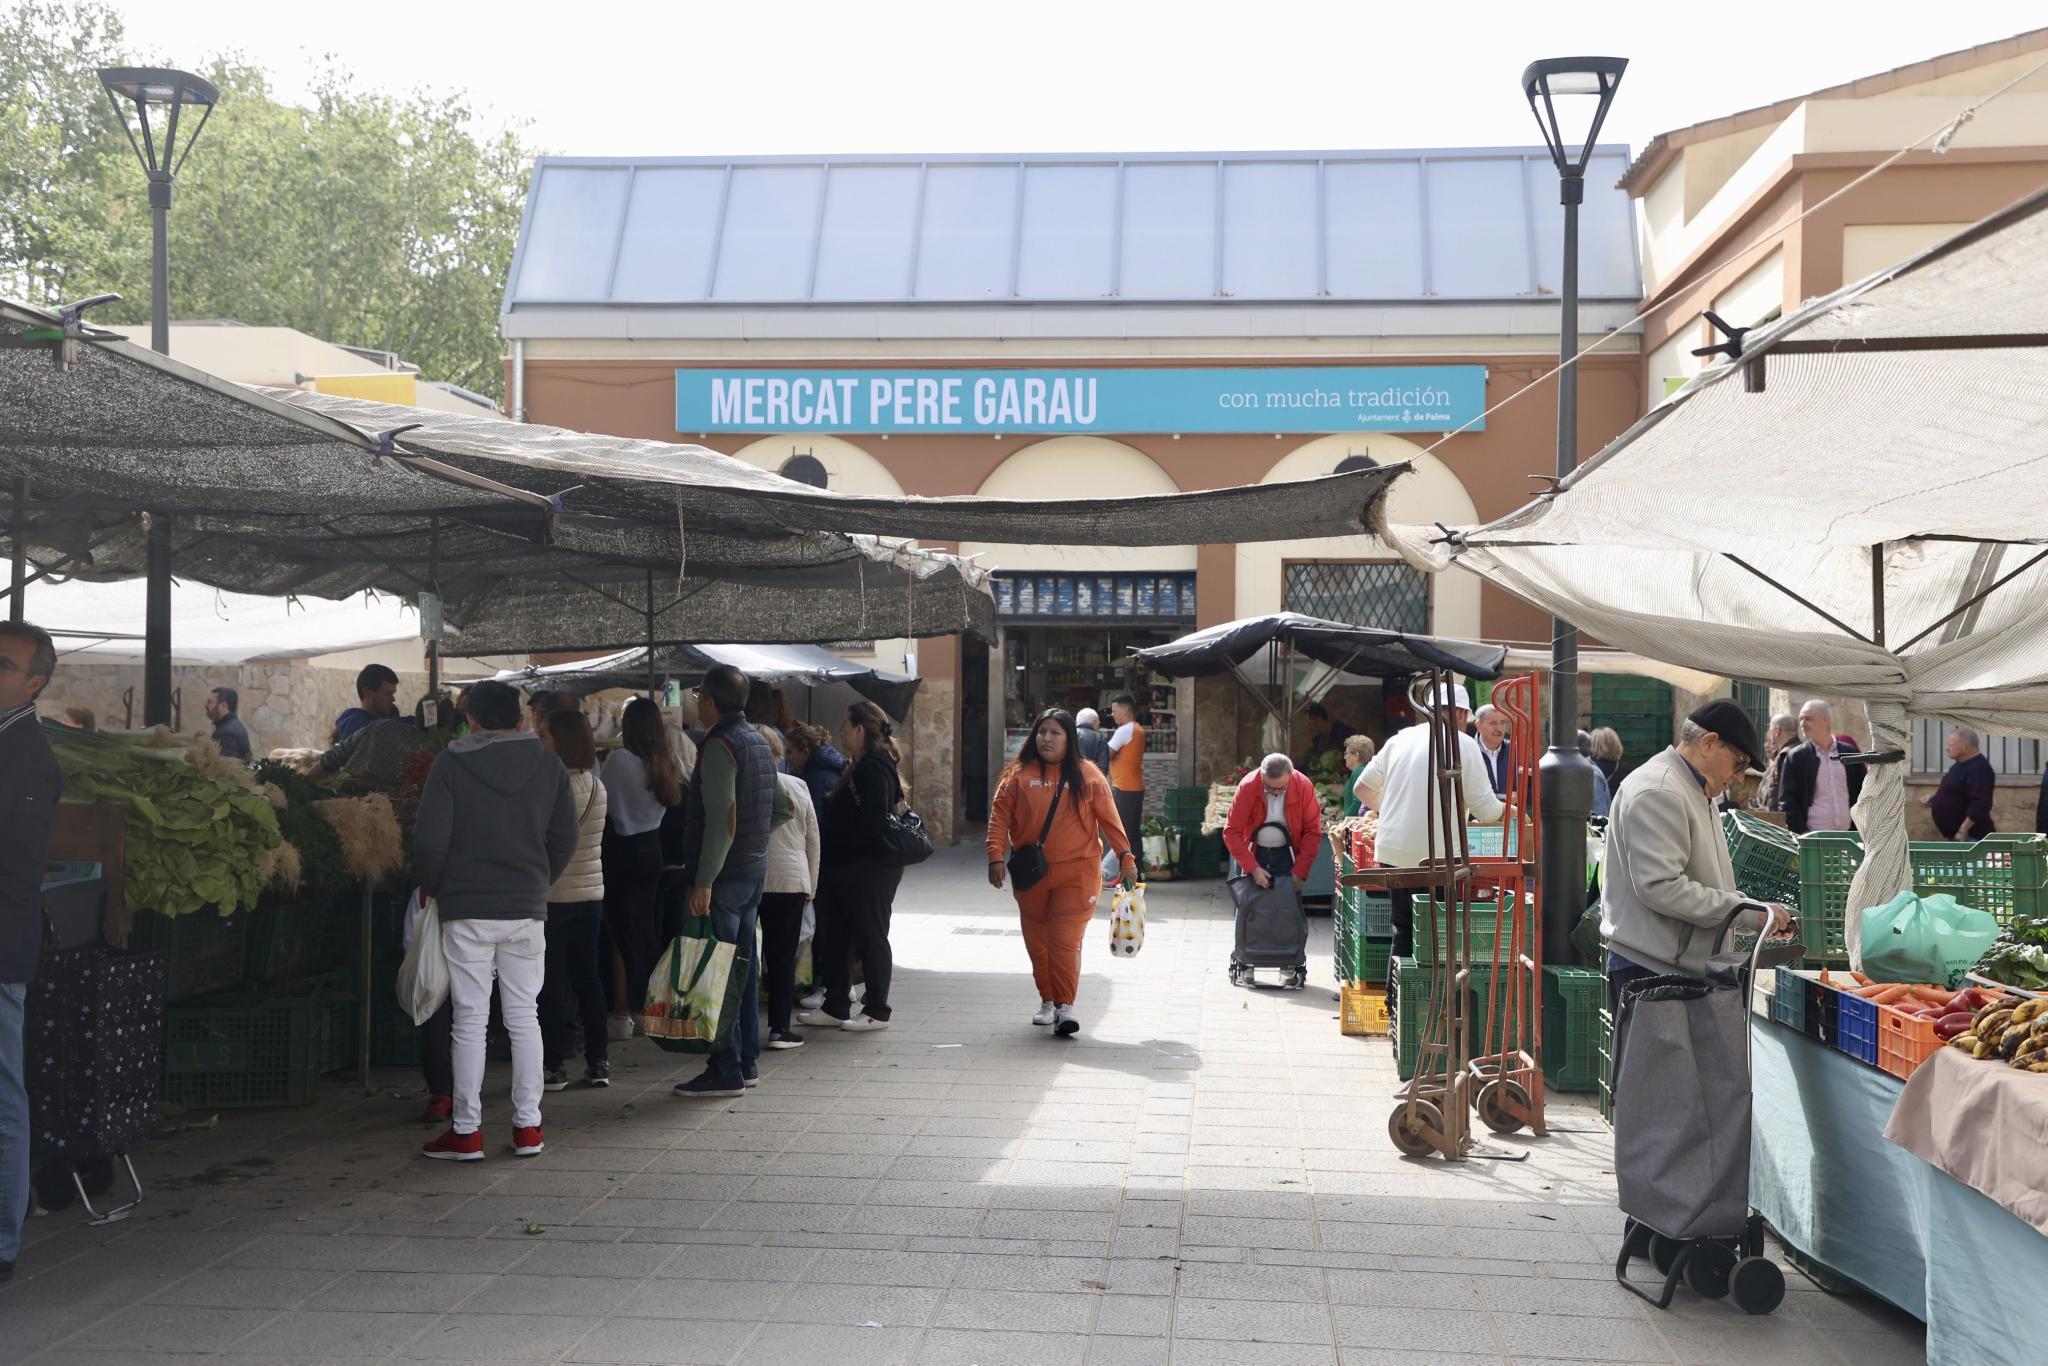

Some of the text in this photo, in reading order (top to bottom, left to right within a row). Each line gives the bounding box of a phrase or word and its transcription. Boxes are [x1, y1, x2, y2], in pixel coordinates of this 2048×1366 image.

[711, 377, 1097, 425] MERCAT PERE GARAU
[1219, 386, 1450, 408] con mucha tradición
[1357, 412, 1451, 423] Ajuntament de Palma
